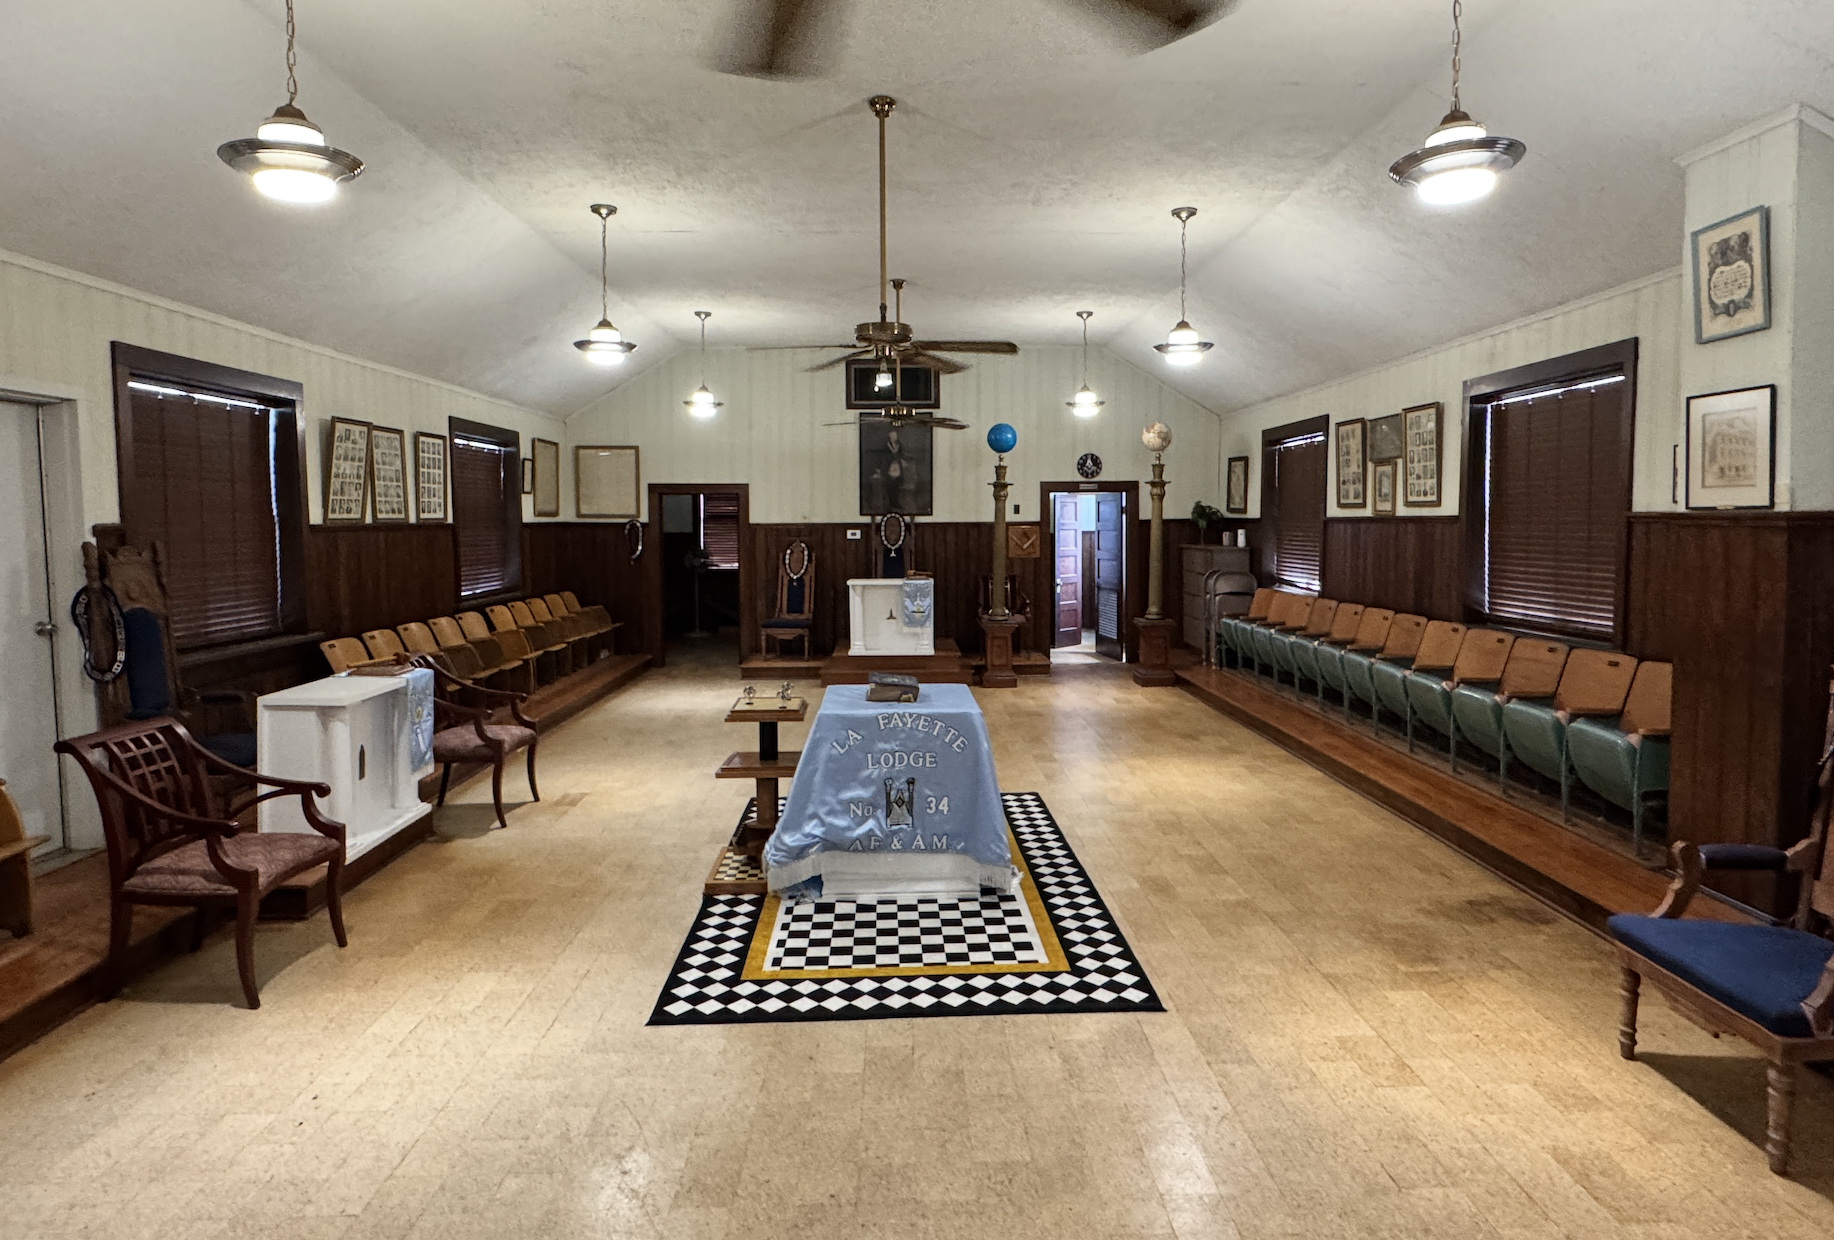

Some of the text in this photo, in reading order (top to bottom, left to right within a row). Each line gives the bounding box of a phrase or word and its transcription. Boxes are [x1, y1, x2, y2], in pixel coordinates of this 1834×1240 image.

[832, 712, 969, 755] LA FAYETTE
[866, 751, 937, 769] LODGE
[926, 796, 950, 815] 34
[891, 834, 903, 850] &
